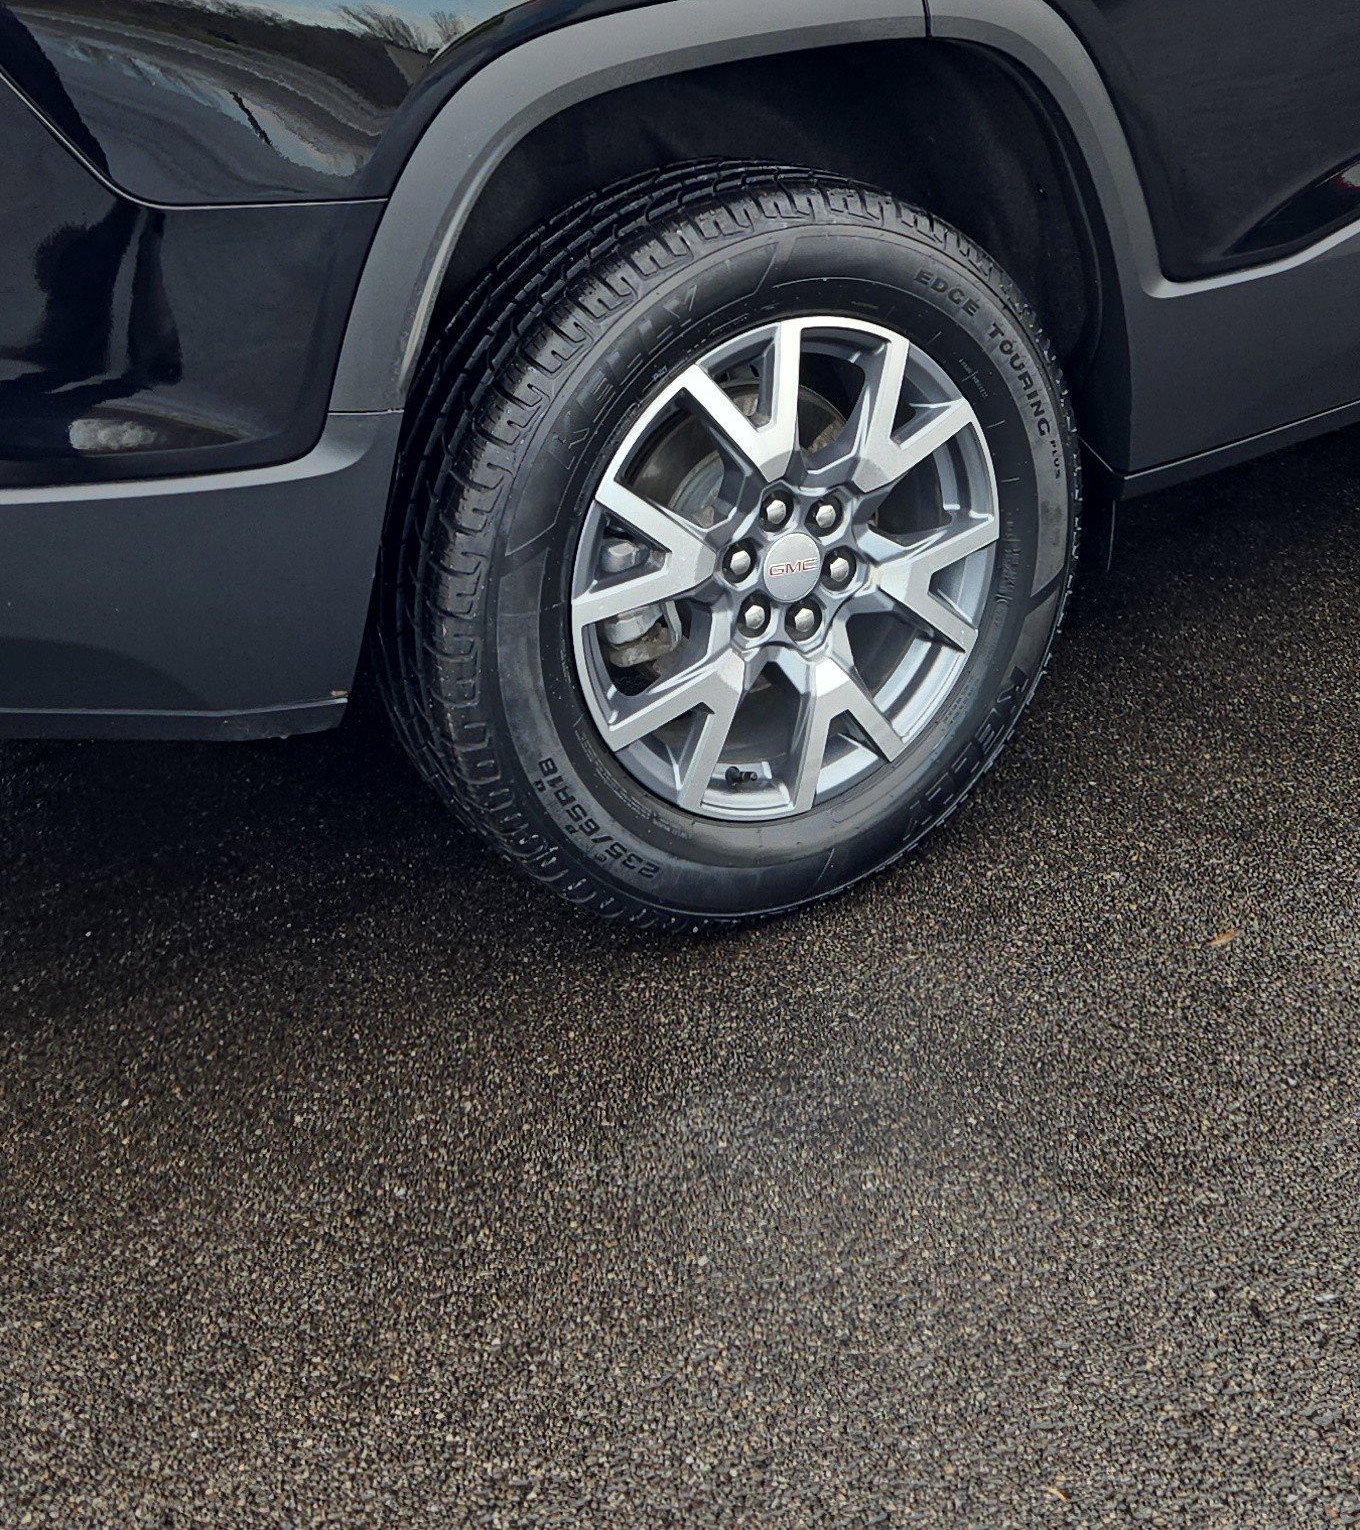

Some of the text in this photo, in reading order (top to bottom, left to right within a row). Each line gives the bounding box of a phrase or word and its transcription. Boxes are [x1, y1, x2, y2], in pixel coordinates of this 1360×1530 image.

[545, 284, 698, 471] KELLY
[914, 268, 981, 317] EDGE
[987, 322, 1052, 437] TOURING
[768, 556, 819, 577] GMC
